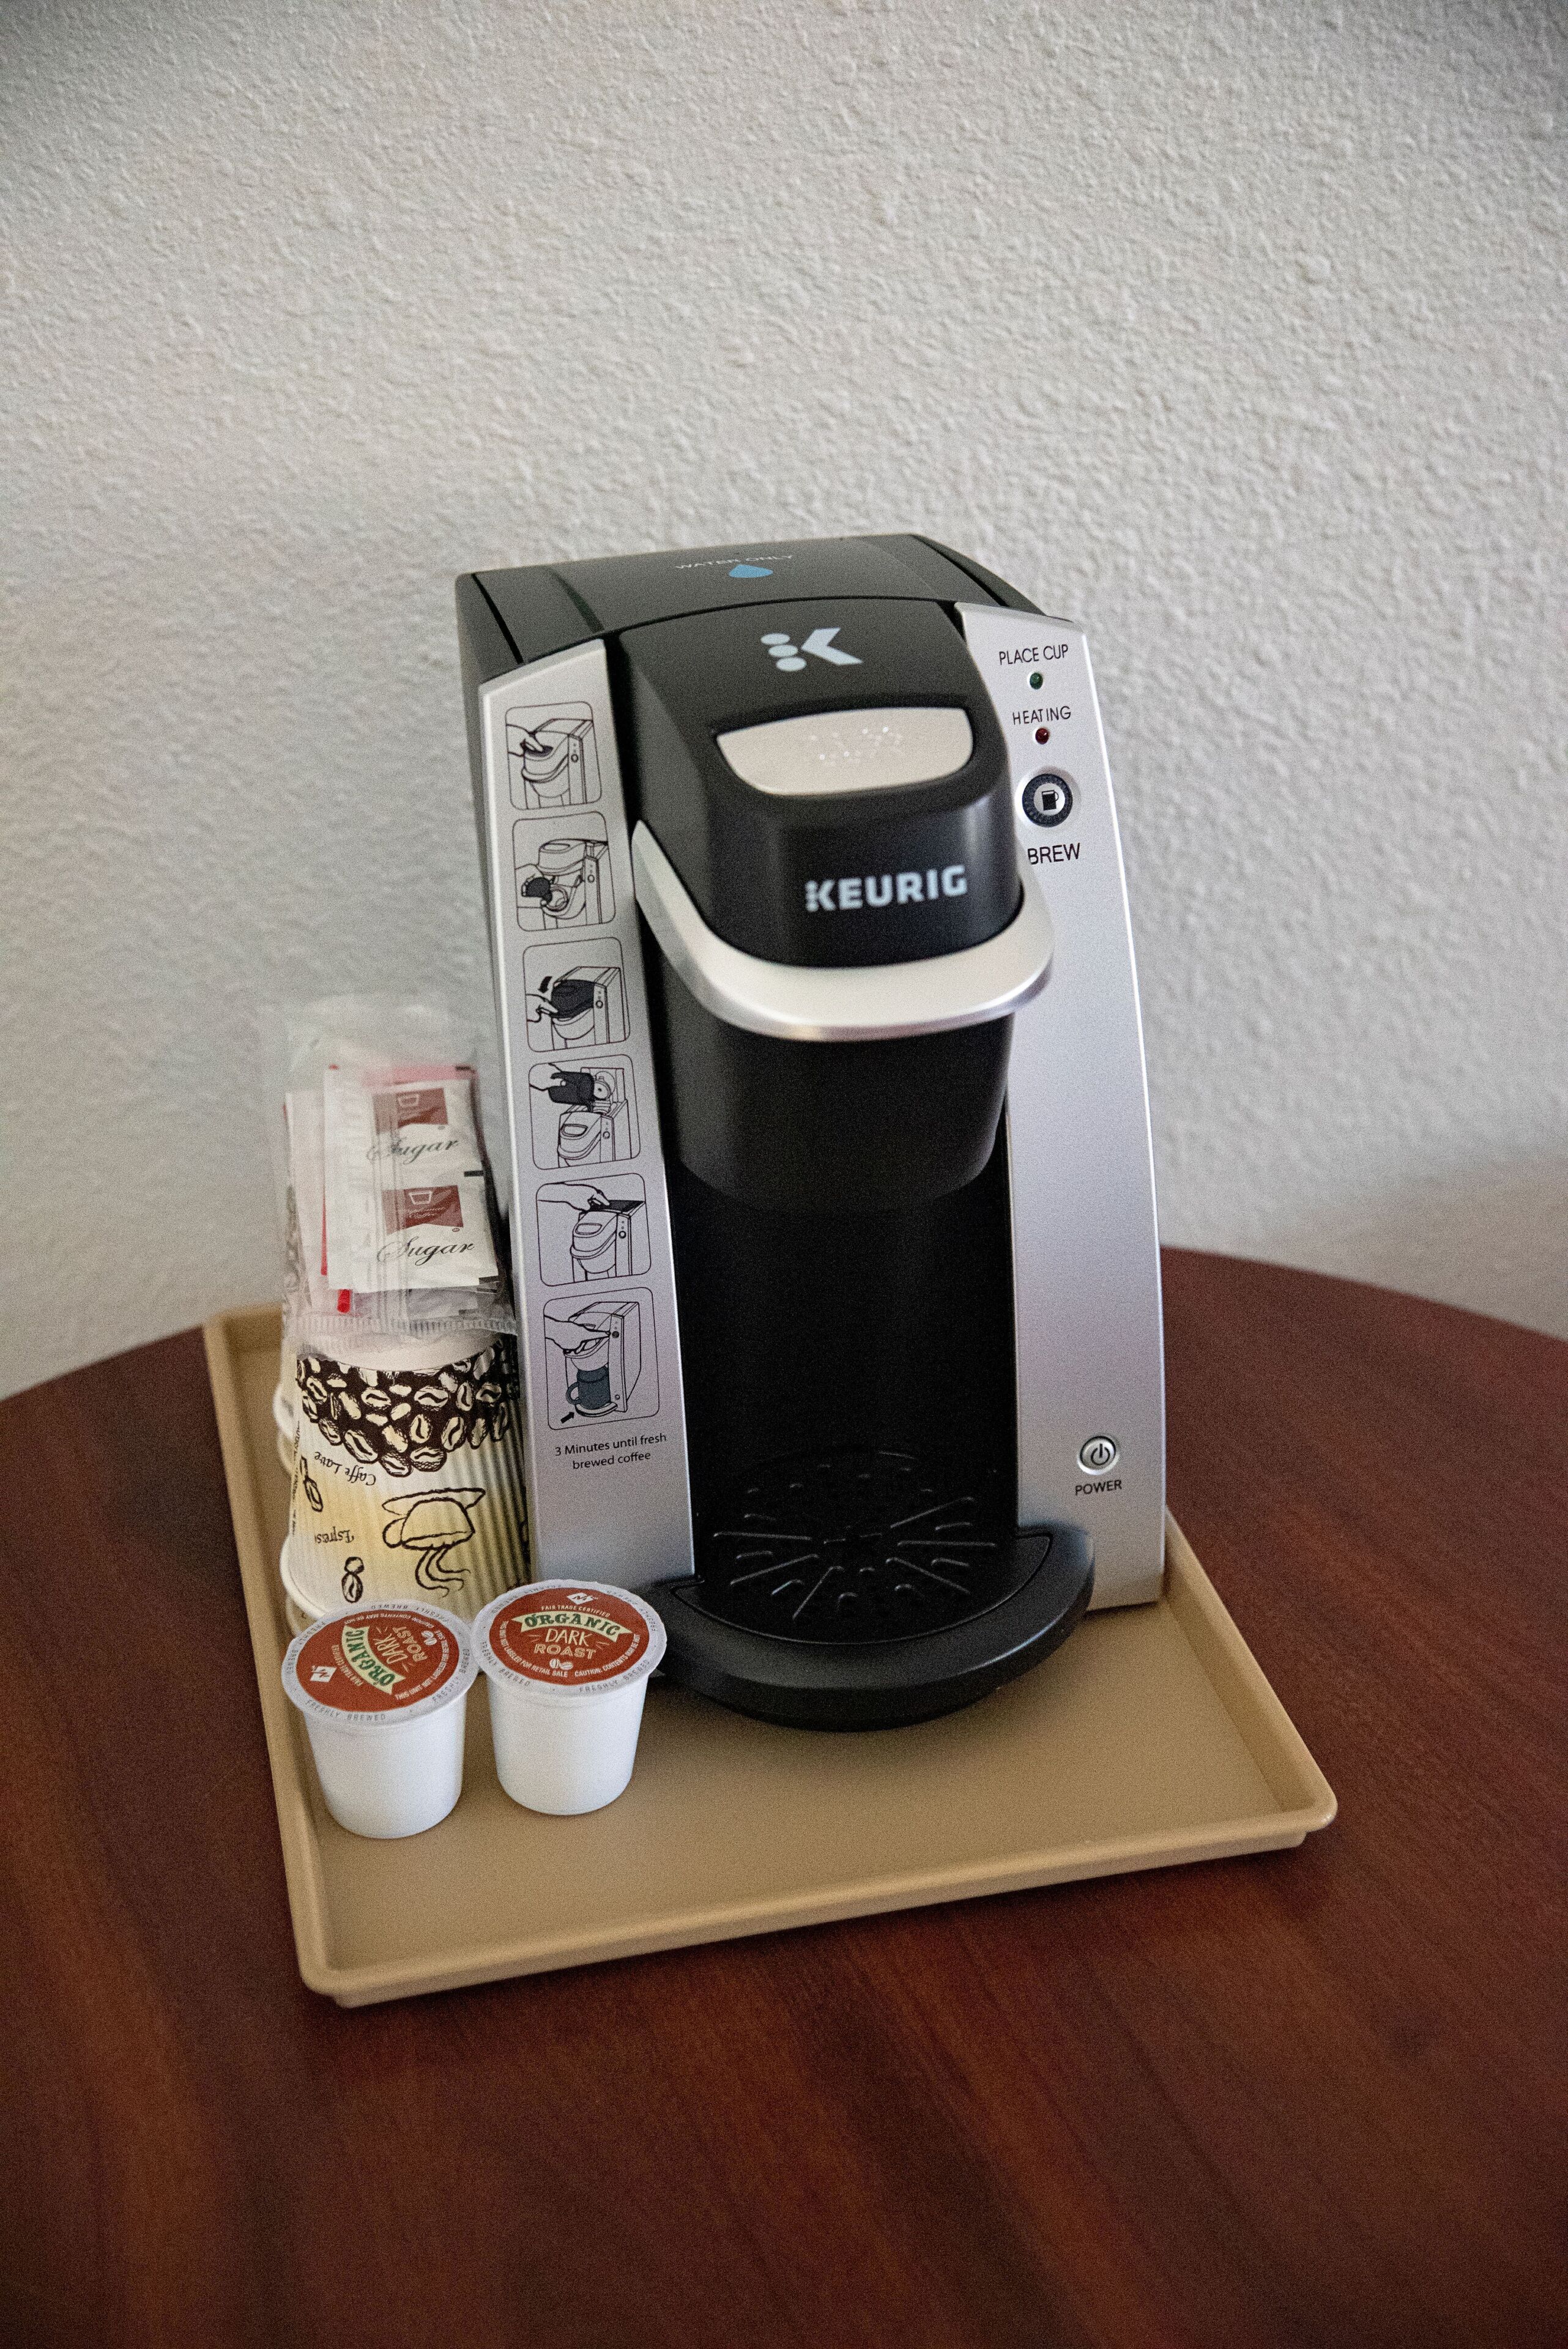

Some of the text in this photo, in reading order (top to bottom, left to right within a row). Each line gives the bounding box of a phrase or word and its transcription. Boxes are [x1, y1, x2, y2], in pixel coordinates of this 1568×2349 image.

[675, 554, 793, 570] WATER ONLY
[998, 644, 1069, 665] PLACE CUP
[1013, 706, 1072, 725] HEATING
[1027, 842, 1081, 865] BREW
[804, 864, 968, 912] KEURIG
[377, 1236, 475, 1267] Sugar
[554, 1433, 667, 1457] 3 Minutes until fresh
[572, 1452, 651, 1471] brewed coffee
[344, 1464, 377, 1486] Caffe
[1074, 1479, 1122, 1496] POWER
[578, 1606, 611, 1618] CERTIFIED
[524, 1613, 621, 1636] ORGANIC
[373, 1633, 409, 1664] DARK
[392, 1626, 428, 1662] ROAST
[545, 1628, 593, 1647] DARK
[345, 1630, 395, 1687] ORGANIC
[503, 1646, 522, 1663] LABELED
[520, 1660, 532, 1669] FOR
[530, 1665, 550, 1675] RETAIL
[533, 1643, 597, 1660] ROAST
[602, 1654, 629, 1671] CONTENTS
[625, 1647, 636, 1657] MAY
[499, 1668, 531, 1687] BREWED
[579, 1660, 650, 1692] FRESHLY BREWED
[395, 1691, 410, 1701] THIS
